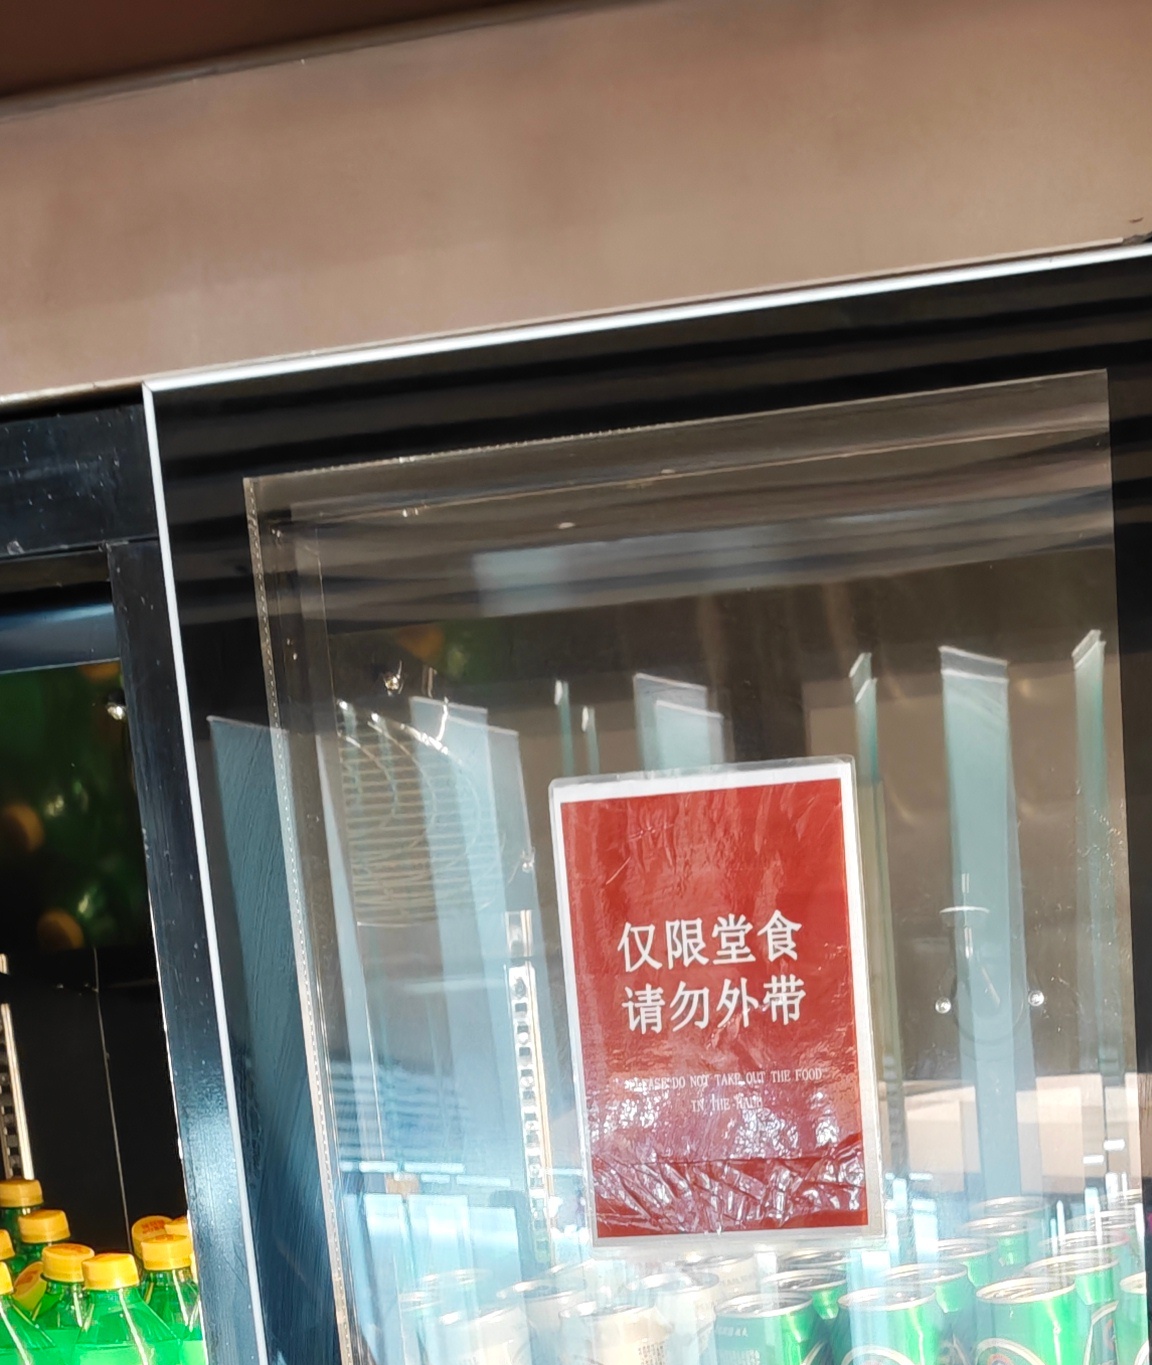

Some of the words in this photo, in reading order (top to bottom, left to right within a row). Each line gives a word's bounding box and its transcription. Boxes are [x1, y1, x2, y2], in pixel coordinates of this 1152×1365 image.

[617, 908, 803, 974] 仅限堂食
[621, 974, 807, 1036] 请勿外带
[672, 1077, 686, 1089] DO
[690, 1075, 709, 1087] NOT
[714, 1073, 741, 1086] TAKE
[746, 1071, 766, 1084] OUT
[770, 1069, 791, 1082] THE
[795, 1067, 823, 1081] FOOD
[692, 1100, 705, 1112] IN
